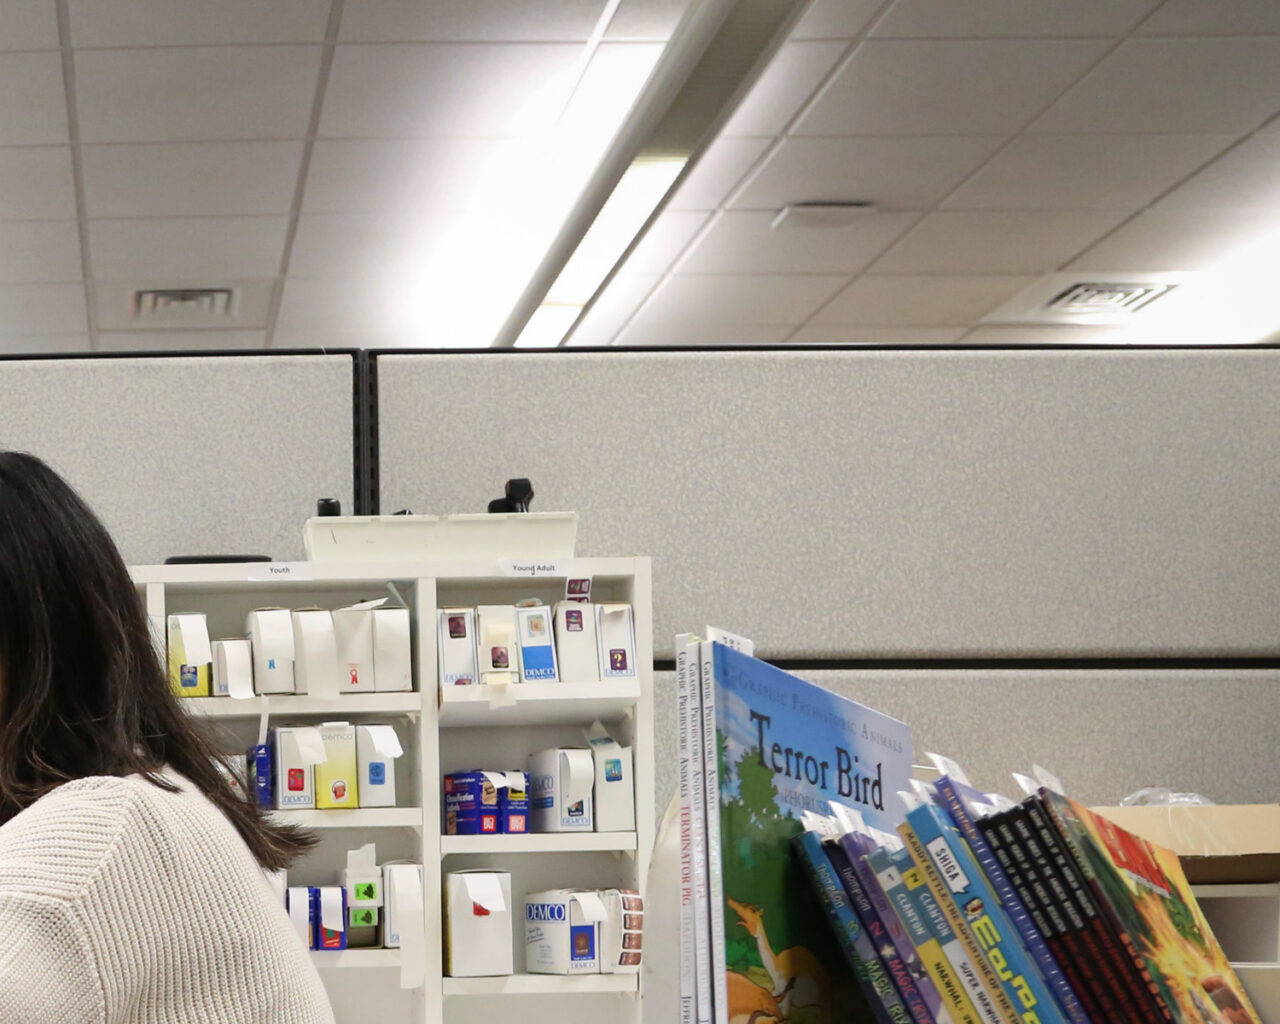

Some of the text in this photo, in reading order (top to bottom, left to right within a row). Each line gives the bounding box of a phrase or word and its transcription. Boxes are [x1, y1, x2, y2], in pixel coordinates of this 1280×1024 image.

[270, 566, 290, 574] Youth
[513, 564, 556, 576] Young Adult
[525, 667, 554, 676] DEMCO
[688, 663, 699, 703] GRAPHIC
[688, 707, 702, 765] PREHISTORIC
[702, 662, 718, 810] GRAPHIC PREHISTORIC ANIMALS
[861, 722, 903, 754] ANIMALS
[677, 652, 695, 906] GRAPHIC PREHISTORIC ANIMALS TERMINATOR PIG
[750, 708, 885, 811] Terror Bird
[691, 770, 704, 811] ANIMALS
[909, 873, 919, 883] 2
[935, 847, 961, 881] SHIGA
[815, 863, 847, 909] Thompson
[841, 866, 884, 937] Thompson 2
[526, 903, 566, 921] DEMCO
[895, 892, 925, 936] CLANTON
[906, 831, 929, 864] MADDY
[924, 864, 949, 901] KETTLE:
[946, 902, 960, 921] THE
[956, 921, 992, 977] ADVENTURE
[988, 977, 999, 990] OF
[996, 991, 1013, 1013] THE
[919, 891, 951, 937] CLANTON
[864, 958, 893, 998] MAGIC
[887, 957, 917, 998] MAGIC
[933, 961, 967, 1012] NARWHAL:
[959, 961, 981, 990] SUPER
